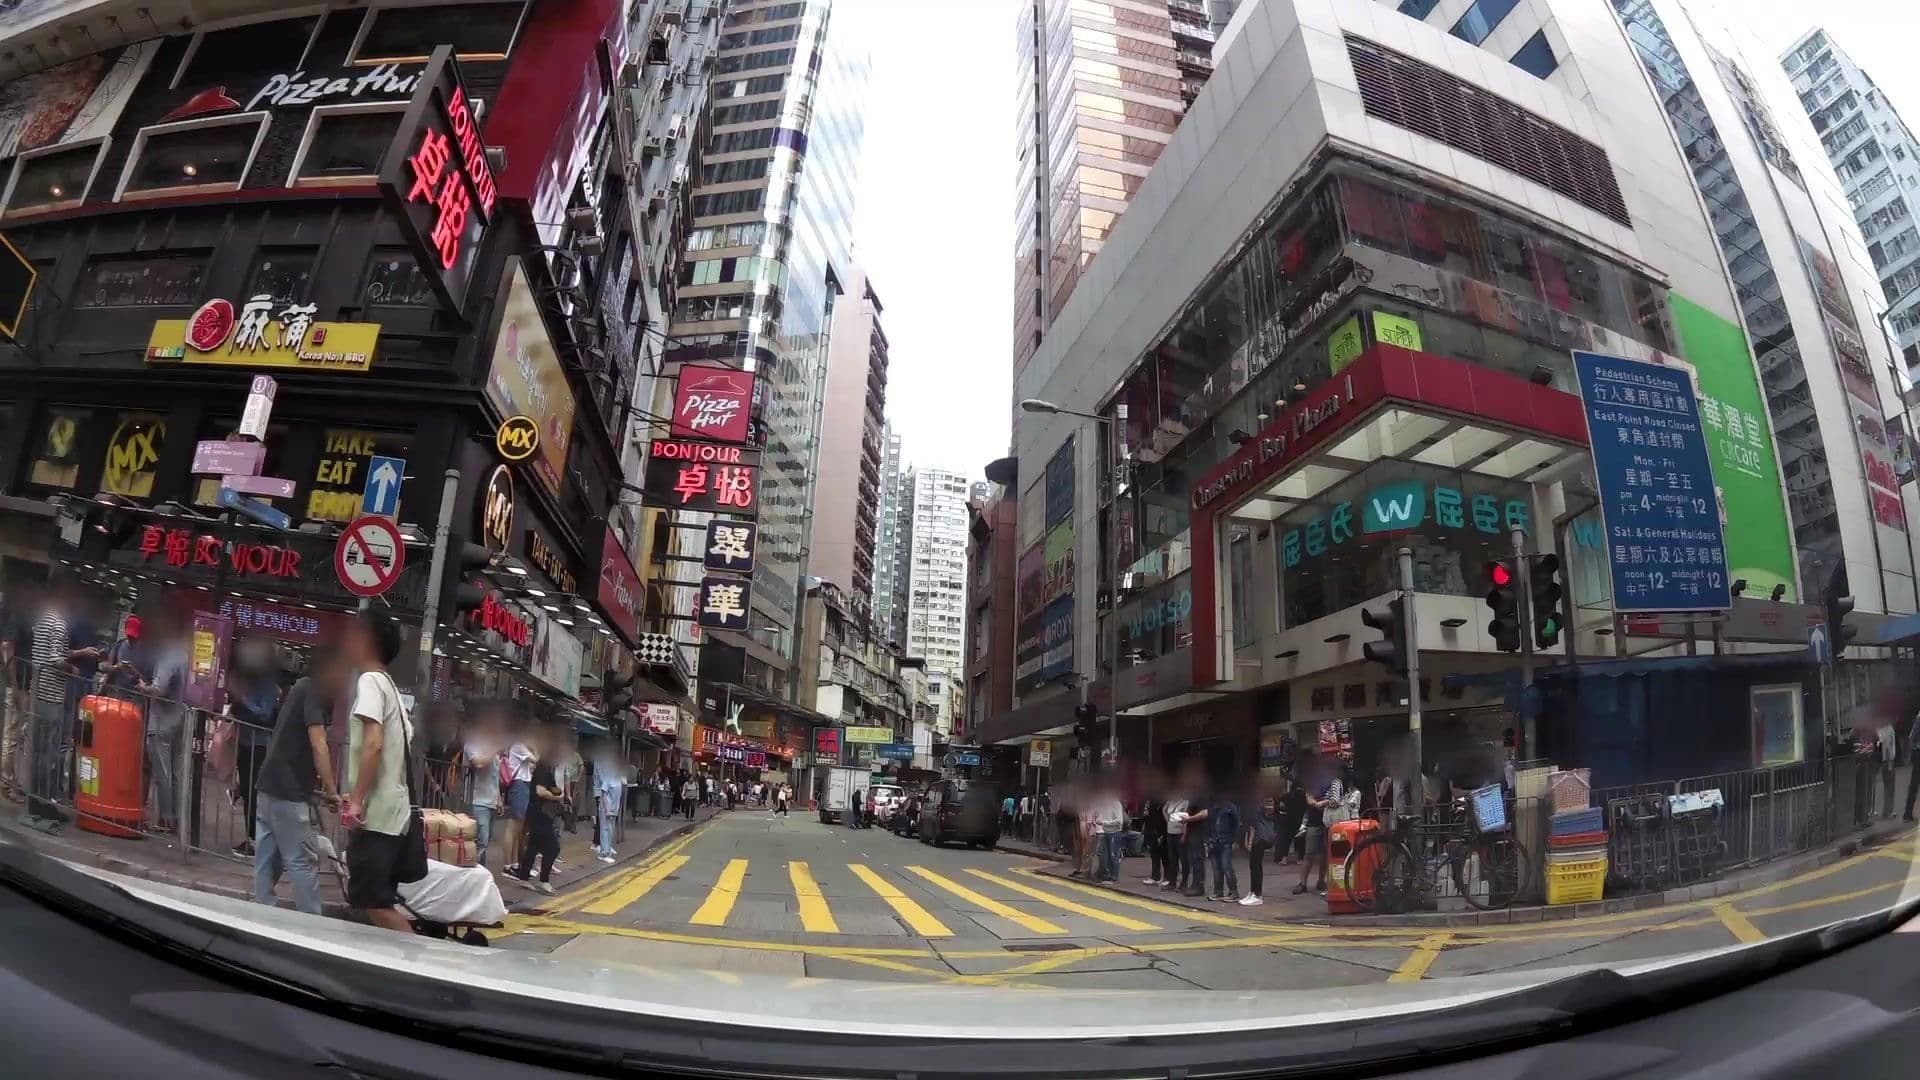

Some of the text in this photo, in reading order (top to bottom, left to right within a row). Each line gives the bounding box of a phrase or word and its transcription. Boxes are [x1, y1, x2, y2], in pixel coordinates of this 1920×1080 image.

[244, 70, 350, 112] Pizza
[448, 86, 499, 218] BONJOUR
[1382, 327, 1414, 348] SUPER
[344, 352, 366, 363] BBQ
[1595, 367, 1680, 390] Pedestrian Scheme
[682, 393, 741, 416] Pizza
[1593, 383, 1689, 412] 行人專用區計劃
[691, 411, 737, 431] Hut
[1259, 430, 1288, 465] Bay
[1292, 394, 1342, 442] Plaza
[1594, 409, 1697, 432] East Point Road Closed
[1703, 393, 1764, 449] 華潤堂
[325, 430, 377, 456] TAKE
[500, 426, 534, 449] MX
[112, 423, 158, 481] MX
[653, 441, 741, 463] BONJOUR
[316, 459, 357, 485] EAT
[1626, 468, 1693, 489] 星期一至五
[486, 481, 513, 547] MX
[1433, 486, 1530, 537] 屈臣氏
[1619, 503, 1685, 518] 下午 午夜
[1620, 491, 1633, 500] pm
[1656, 494, 1688, 505] midnight
[1692, 498, 1707, 515] 12
[1283, 502, 1353, 569] 屈臣氏
[1614, 526, 1634, 538] Sat.
[1644, 527, 1680, 540] General
[1680, 529, 1717, 541] Holidays
[1615, 544, 1722, 564] 星期六及公眾假期
[703, 524, 751, 624] 翠華
[1624, 570, 1645, 580] noon
[1671, 569, 1705, 582] midnight
[1707, 570, 1721, 589] 12
[1626, 583, 1700, 598] 中午 午夜
